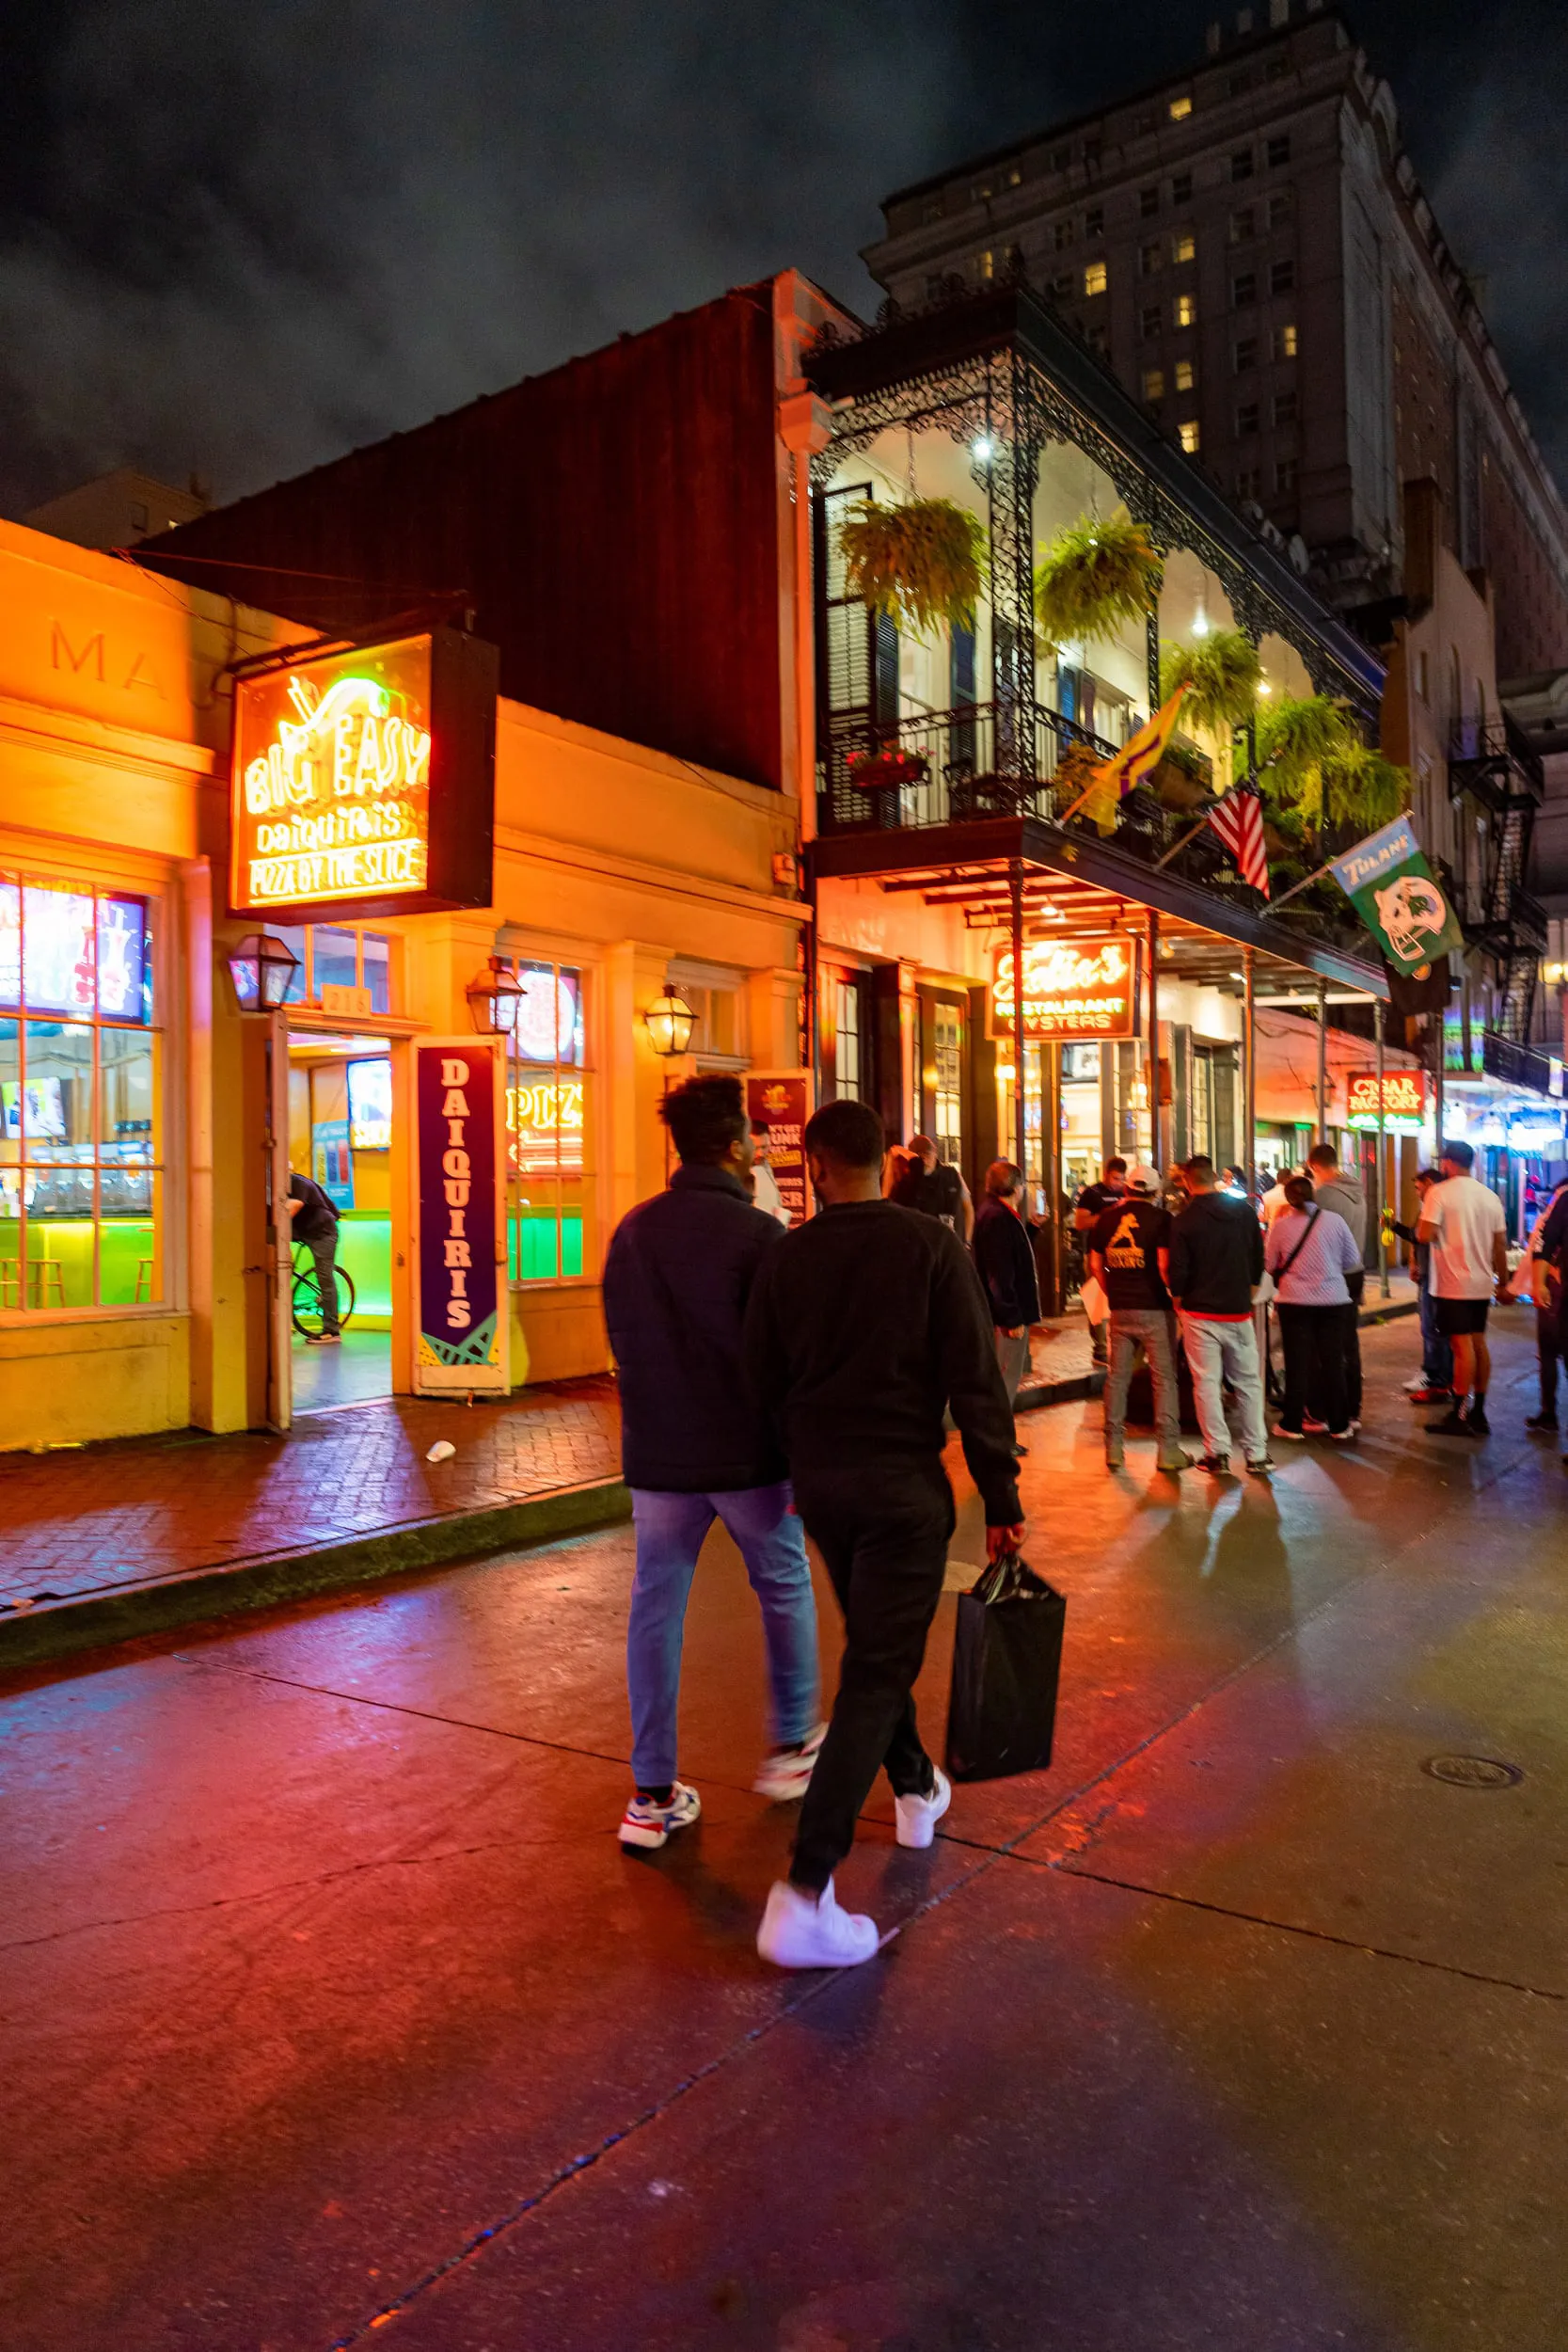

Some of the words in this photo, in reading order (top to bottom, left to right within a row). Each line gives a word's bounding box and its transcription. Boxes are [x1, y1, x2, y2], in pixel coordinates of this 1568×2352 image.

[245, 726, 315, 814] BIG
[334, 714, 430, 796] EASY
[249, 856, 294, 896] PIZZA
[298, 854, 323, 894] BY
[327, 849, 363, 888] THE
[364, 845, 420, 884] SLICE
[440, 1058, 471, 1327] DAIQUIRIS
